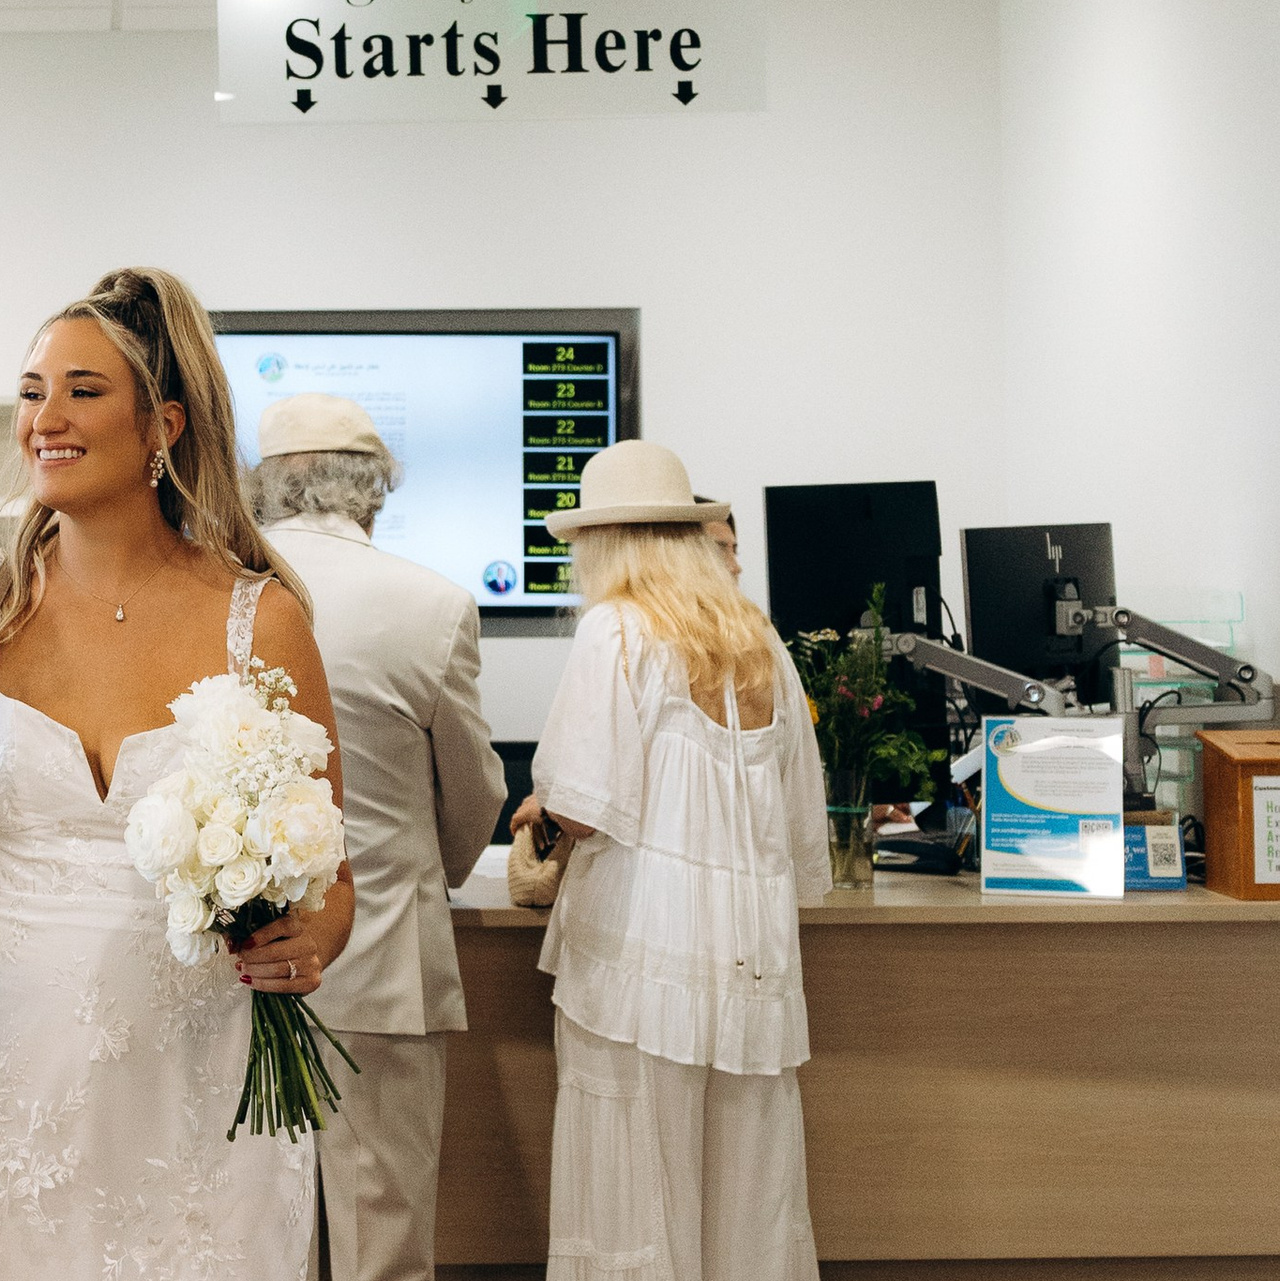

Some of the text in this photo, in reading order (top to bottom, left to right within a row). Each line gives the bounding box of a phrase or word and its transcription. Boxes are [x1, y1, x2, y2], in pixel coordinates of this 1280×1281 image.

[285, 12, 702, 81] Starts Here
[555, 346, 575, 361] 24
[555, 383, 576, 398] 23
[556, 419, 576, 434] 22
[556, 455, 576, 471] 21
[556, 492, 576, 508] 20
